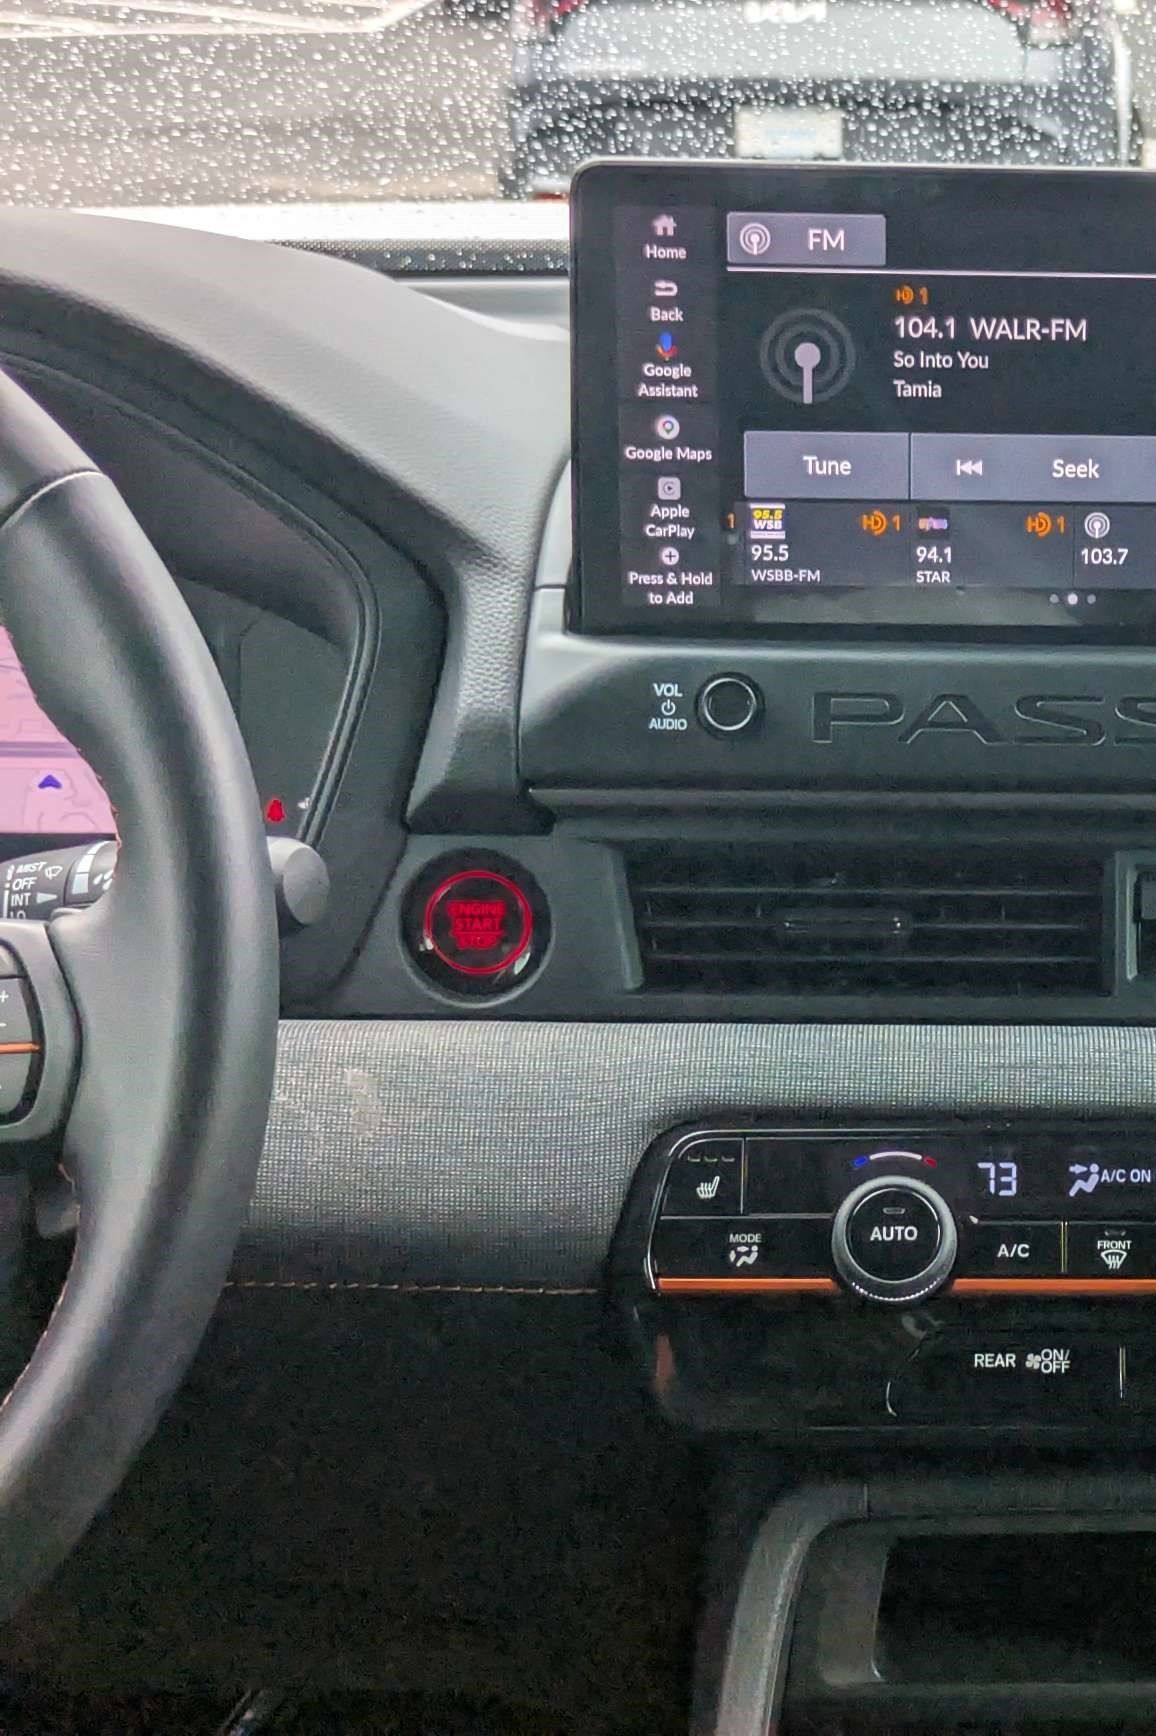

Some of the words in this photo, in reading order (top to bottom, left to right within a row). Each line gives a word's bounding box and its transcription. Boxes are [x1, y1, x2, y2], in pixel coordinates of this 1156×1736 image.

[808, 230, 845, 251] FM
[645, 245, 687, 260] Home
[650, 307, 684, 322] Back
[894, 317, 957, 339] 104.1
[969, 318, 1088, 341] WALR-FM
[893, 350, 915, 369] So
[920, 351, 953, 369] Into
[957, 351, 990, 369] You
[643, 364, 692, 379] Google
[638, 383, 699, 397] Assistant
[893, 379, 943, 398] Tamia
[625, 447, 673, 461] Google
[676, 447, 712, 462] Maps
[803, 456, 852, 475] Tune
[1051, 458, 1100, 478] Seek
[650, 504, 690, 520] Apple
[892, 515, 901, 532] 1
[1057, 516, 1066, 534] 1
[645, 524, 695, 540] CarPlay
[751, 545, 789, 562] 95.5
[916, 546, 951, 563] 94.1
[1081, 548, 1128, 566] 103.7
[629, 572, 664, 586] Press
[666, 573, 678, 586] &
[681, 572, 713, 587] Hold
[751, 568, 821, 583] WSBB-FM
[916, 570, 951, 583] STAR
[648, 592, 663, 605] to
[666, 591, 694, 605] Add
[653, 683, 683, 698] VOL
[648, 717, 688, 731] AUDIO
[12, 876, 37, 891] OFF
[11, 892, 32, 907] INT
[976, 1162, 1018, 1197] 73
[1101, 1169, 1126, 1184] A/C
[1130, 1169, 1151, 1183] ON
[729, 1233, 763, 1243] MODE
[869, 1226, 918, 1242] AUTO
[997, 1243, 1030, 1258] A/C
[1097, 1239, 1132, 1250] FRONT
[973, 1353, 1016, 1368] REAR
[1041, 1348, 1070, 1361] ON/
[1041, 1361, 1071, 1374] OFF
